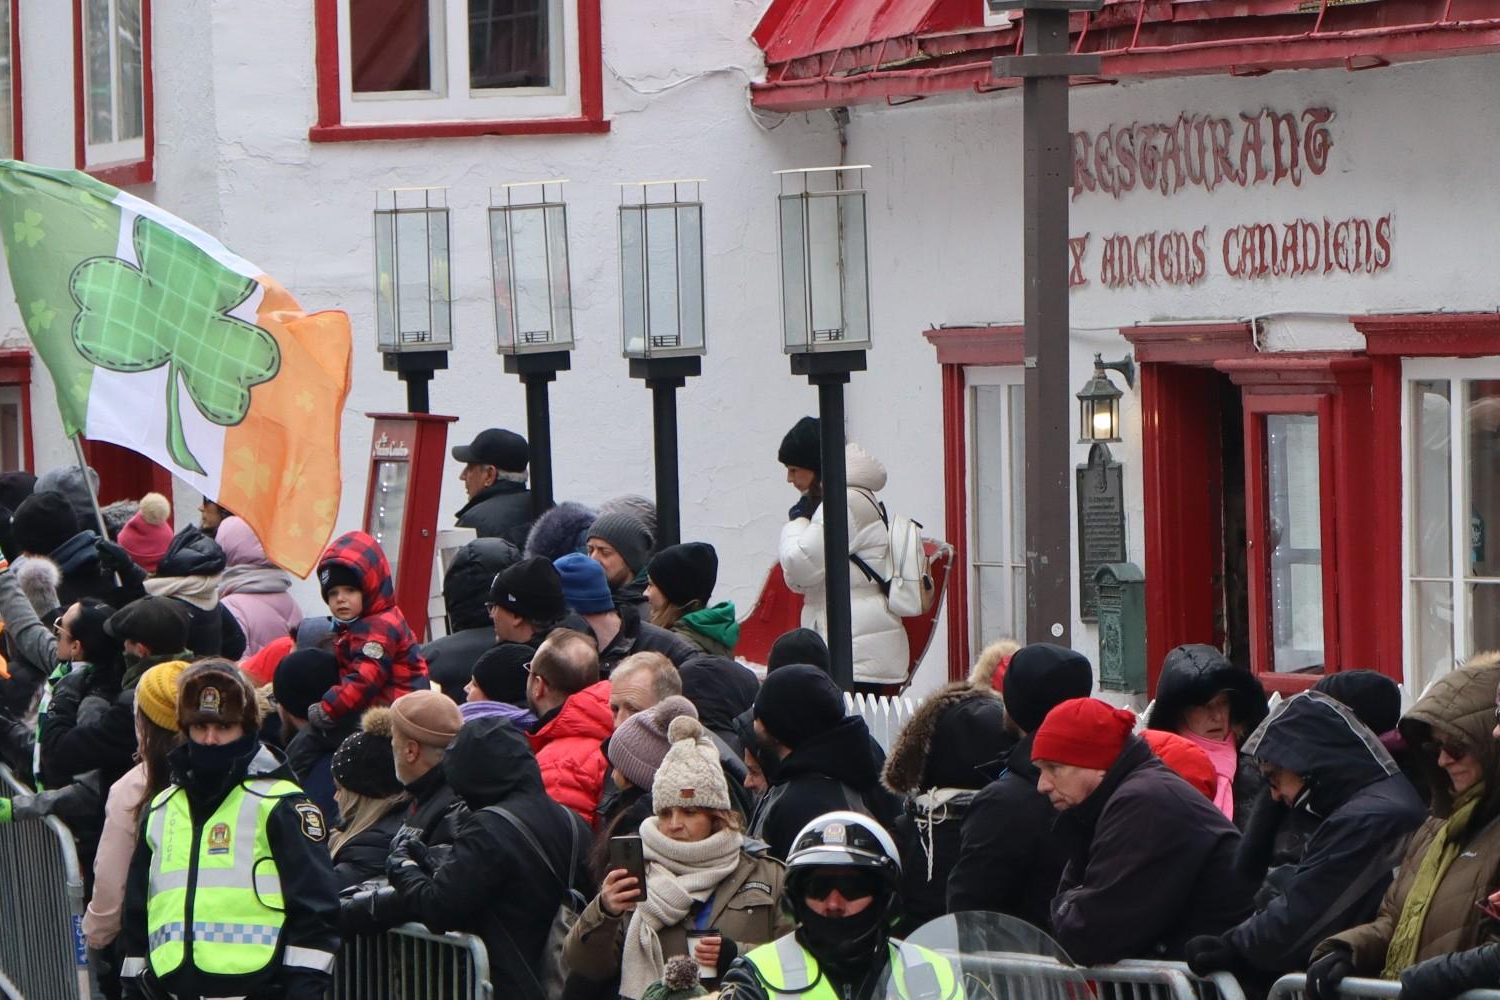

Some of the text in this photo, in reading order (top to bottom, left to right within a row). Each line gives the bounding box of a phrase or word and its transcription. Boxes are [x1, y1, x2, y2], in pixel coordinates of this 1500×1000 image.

[1071, 107, 1337, 203] RESTAURANT
[1100, 225, 1206, 289] ANCIENS
[1222, 213, 1392, 281] CANADIENS
